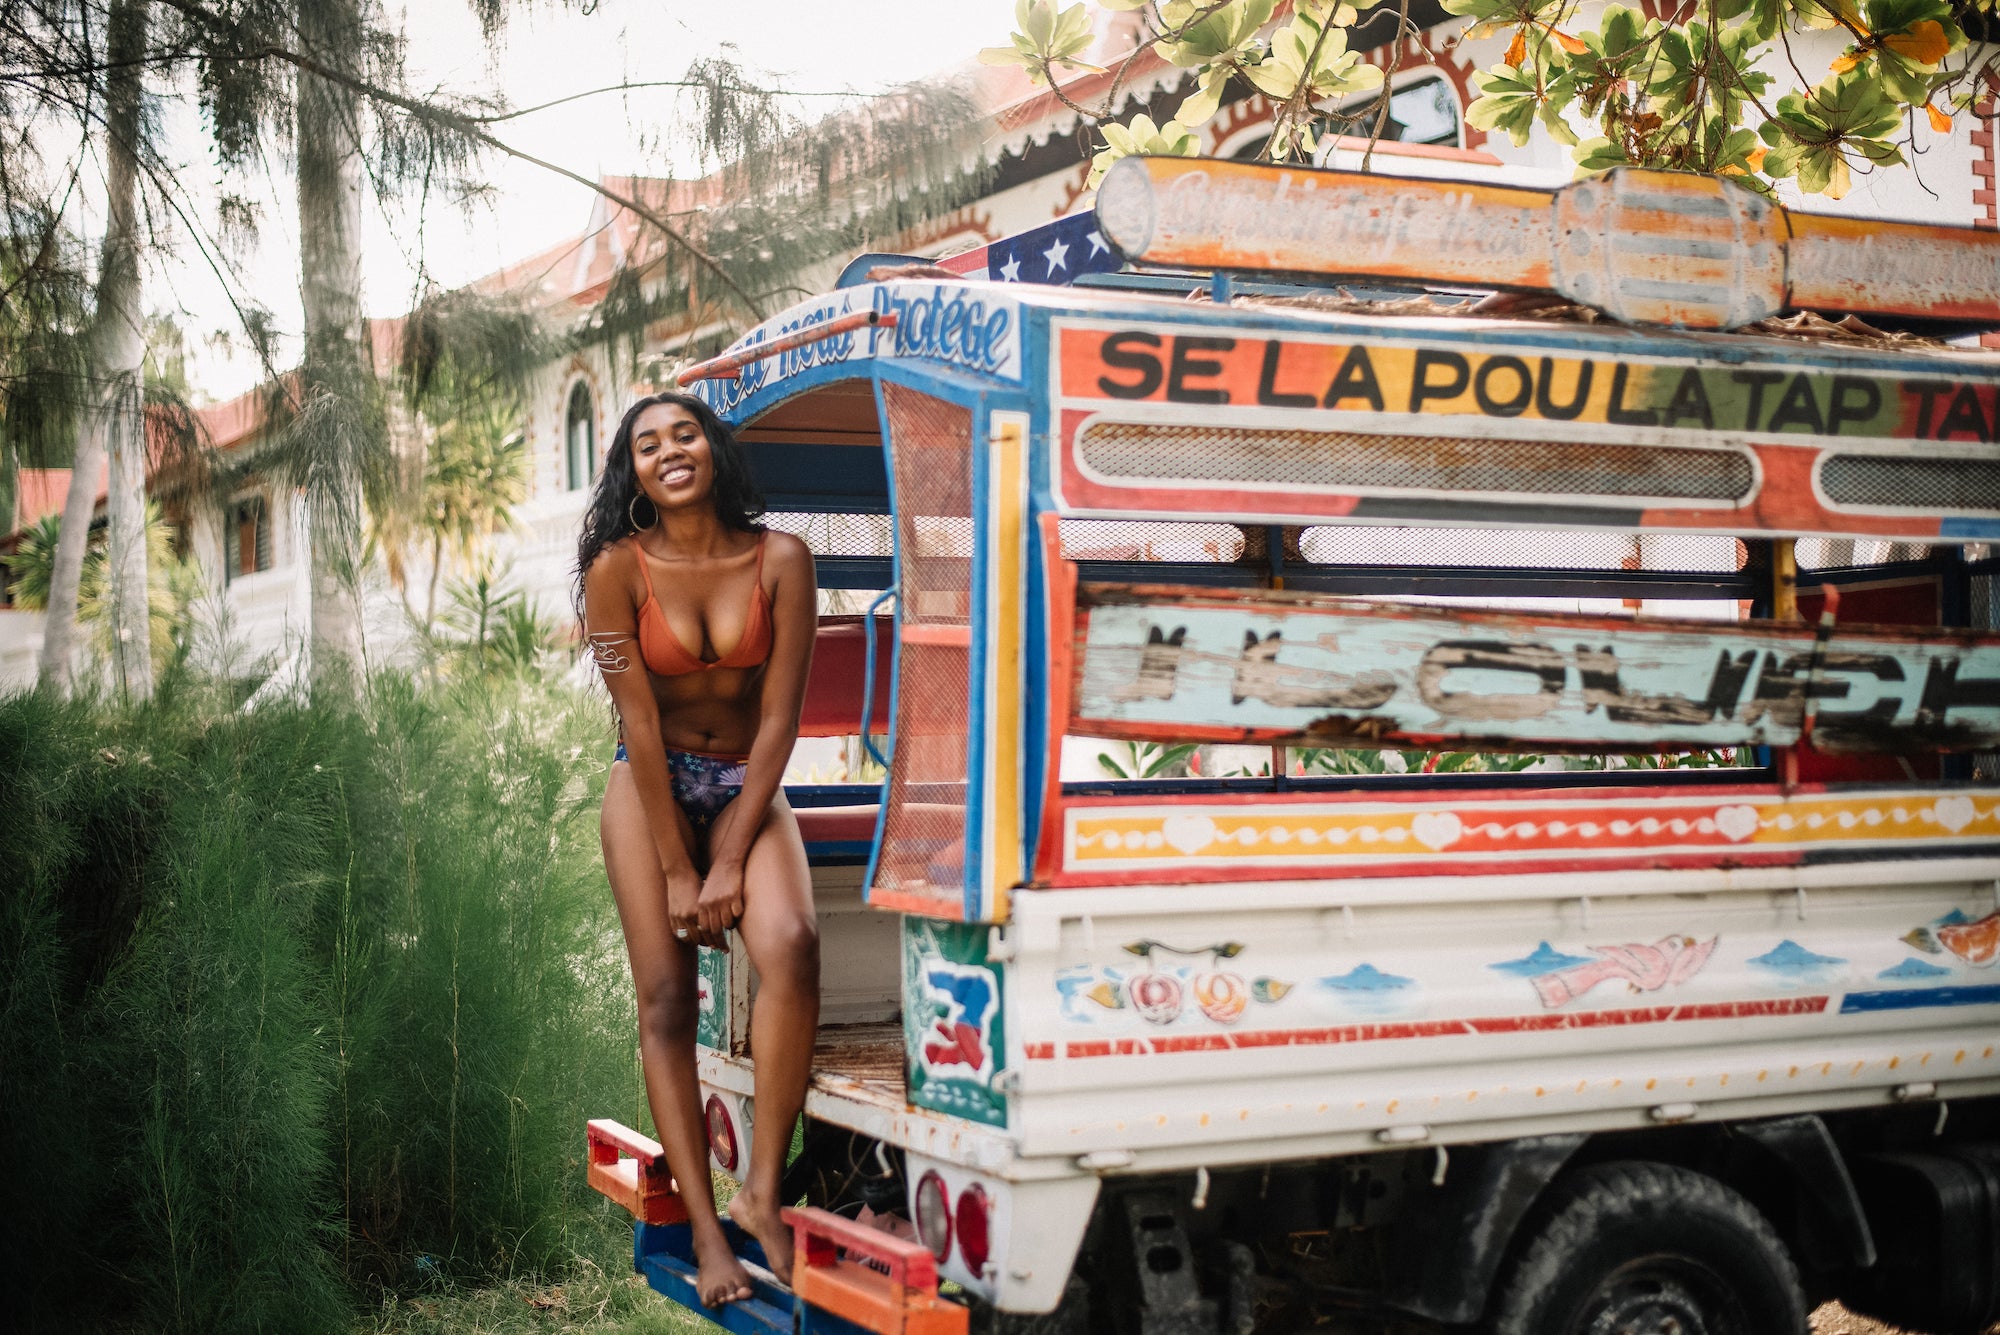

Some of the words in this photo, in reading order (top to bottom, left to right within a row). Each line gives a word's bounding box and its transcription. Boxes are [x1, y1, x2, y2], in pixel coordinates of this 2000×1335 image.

[1097, 331, 1236, 405] SE
[1257, 339, 1385, 413] LA
[1731, 370, 1882, 436] TAP
[1903, 379, 2000, 443] TA
